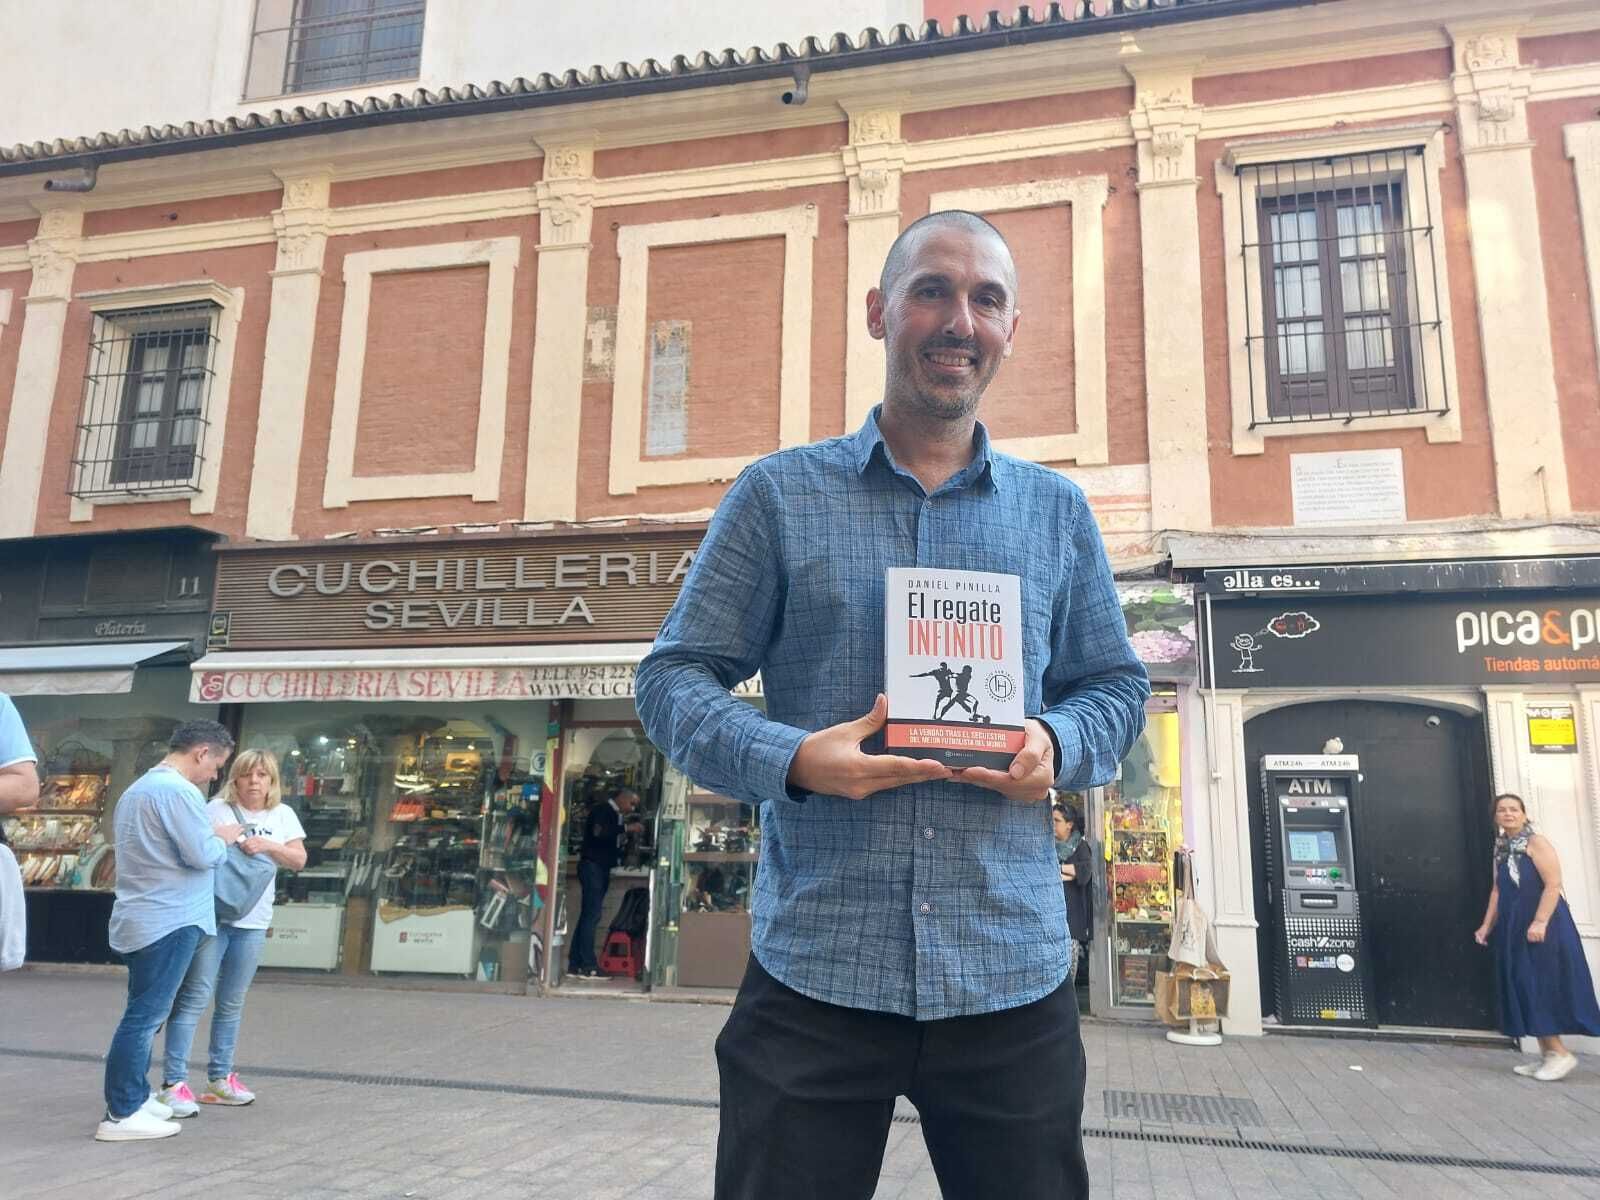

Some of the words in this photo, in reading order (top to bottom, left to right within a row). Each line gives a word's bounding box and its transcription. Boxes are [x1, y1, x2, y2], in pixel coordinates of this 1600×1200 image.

[268, 550, 697, 597] CUCHILLERIA
[178, 576, 200, 598] 11
[908, 579, 949, 590] DANIEL
[956, 582, 1000, 593] PINILLA
[364, 596, 595, 630] SEVILLA
[908, 592, 925, 619] El
[933, 599, 1001, 625] regate
[908, 619, 1003, 661] INFINITO
[580, 666, 606, 679] 954
[610, 665, 627, 679] 22
[1484, 657, 1541, 672] Tiendas
[225, 671, 401, 698] CUCHILLERIA
[407, 669, 529, 697] SEVILLA
[910, 728, 918, 736] LA
[1288, 778, 1332, 795] ATM
